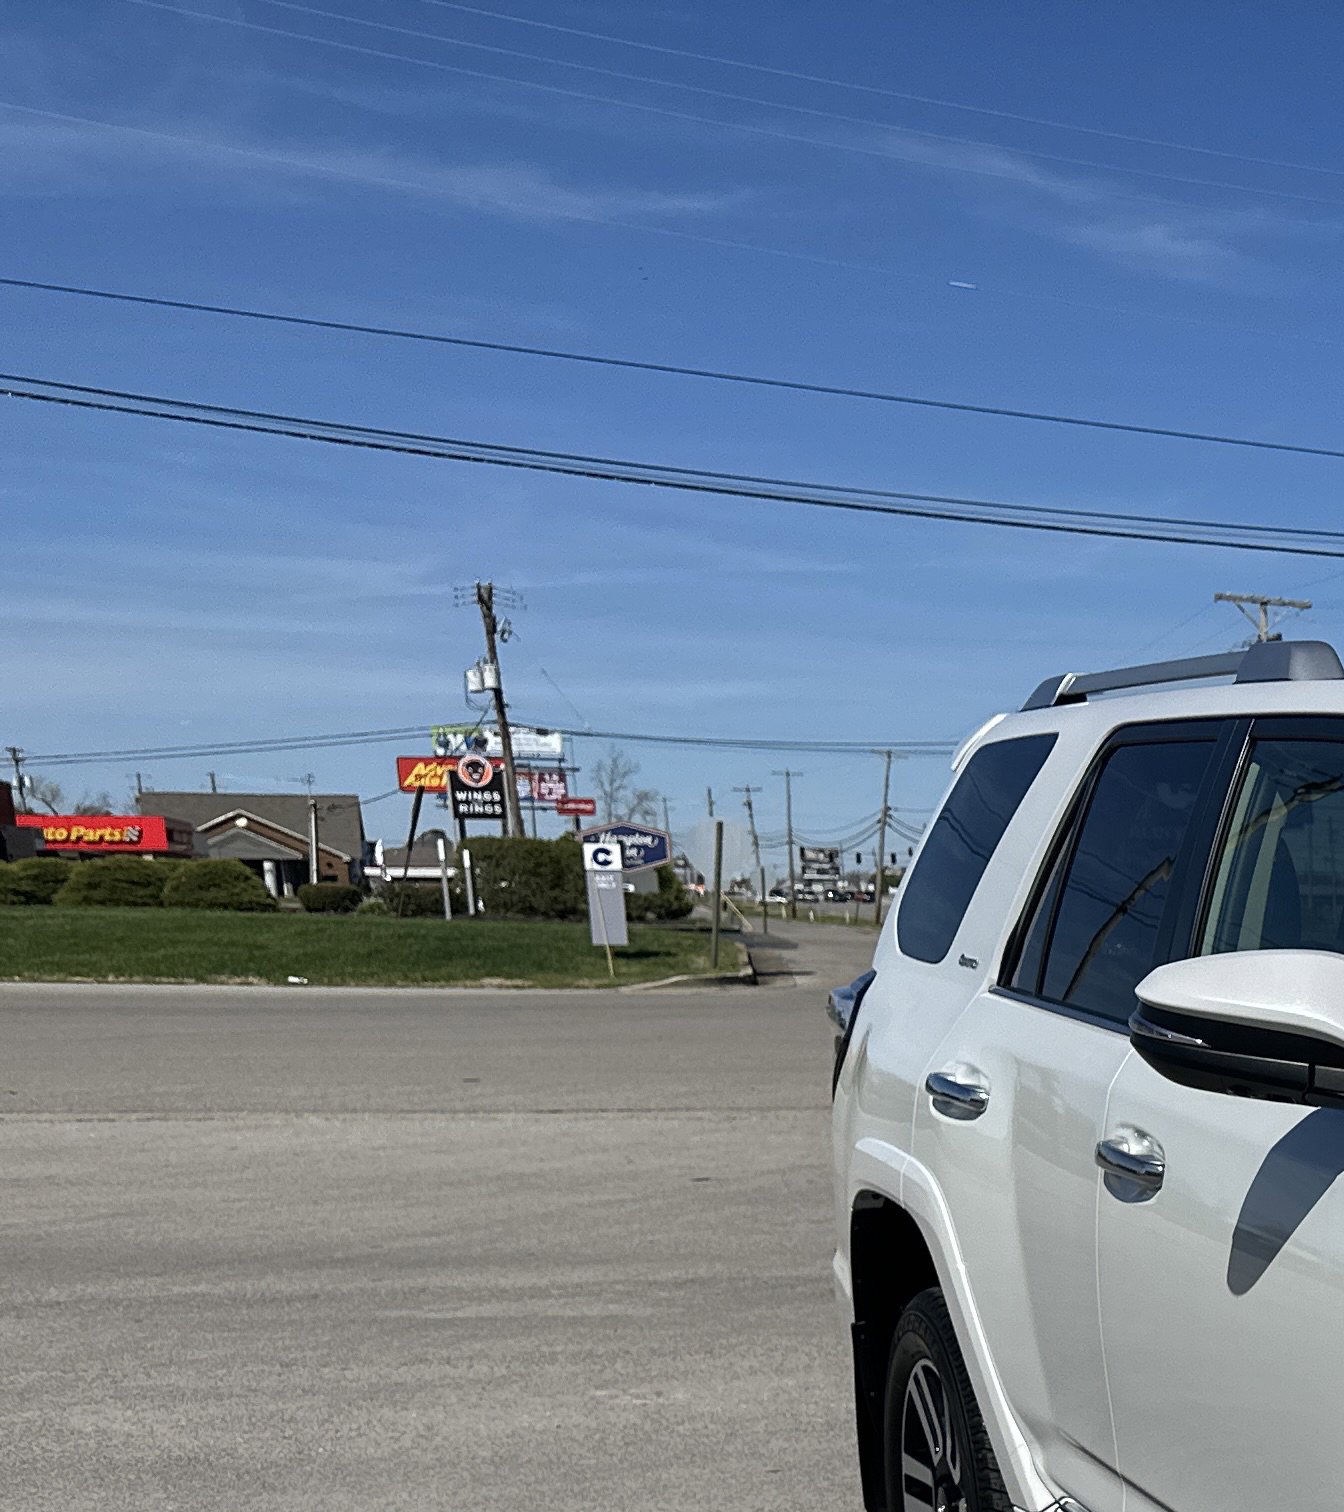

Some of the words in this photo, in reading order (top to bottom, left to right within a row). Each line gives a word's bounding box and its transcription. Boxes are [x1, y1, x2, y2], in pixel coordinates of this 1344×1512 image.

[455, 790, 501, 802] WINGS
[458, 803, 503, 815] RINGS
[70, 825, 122, 841] Parts
